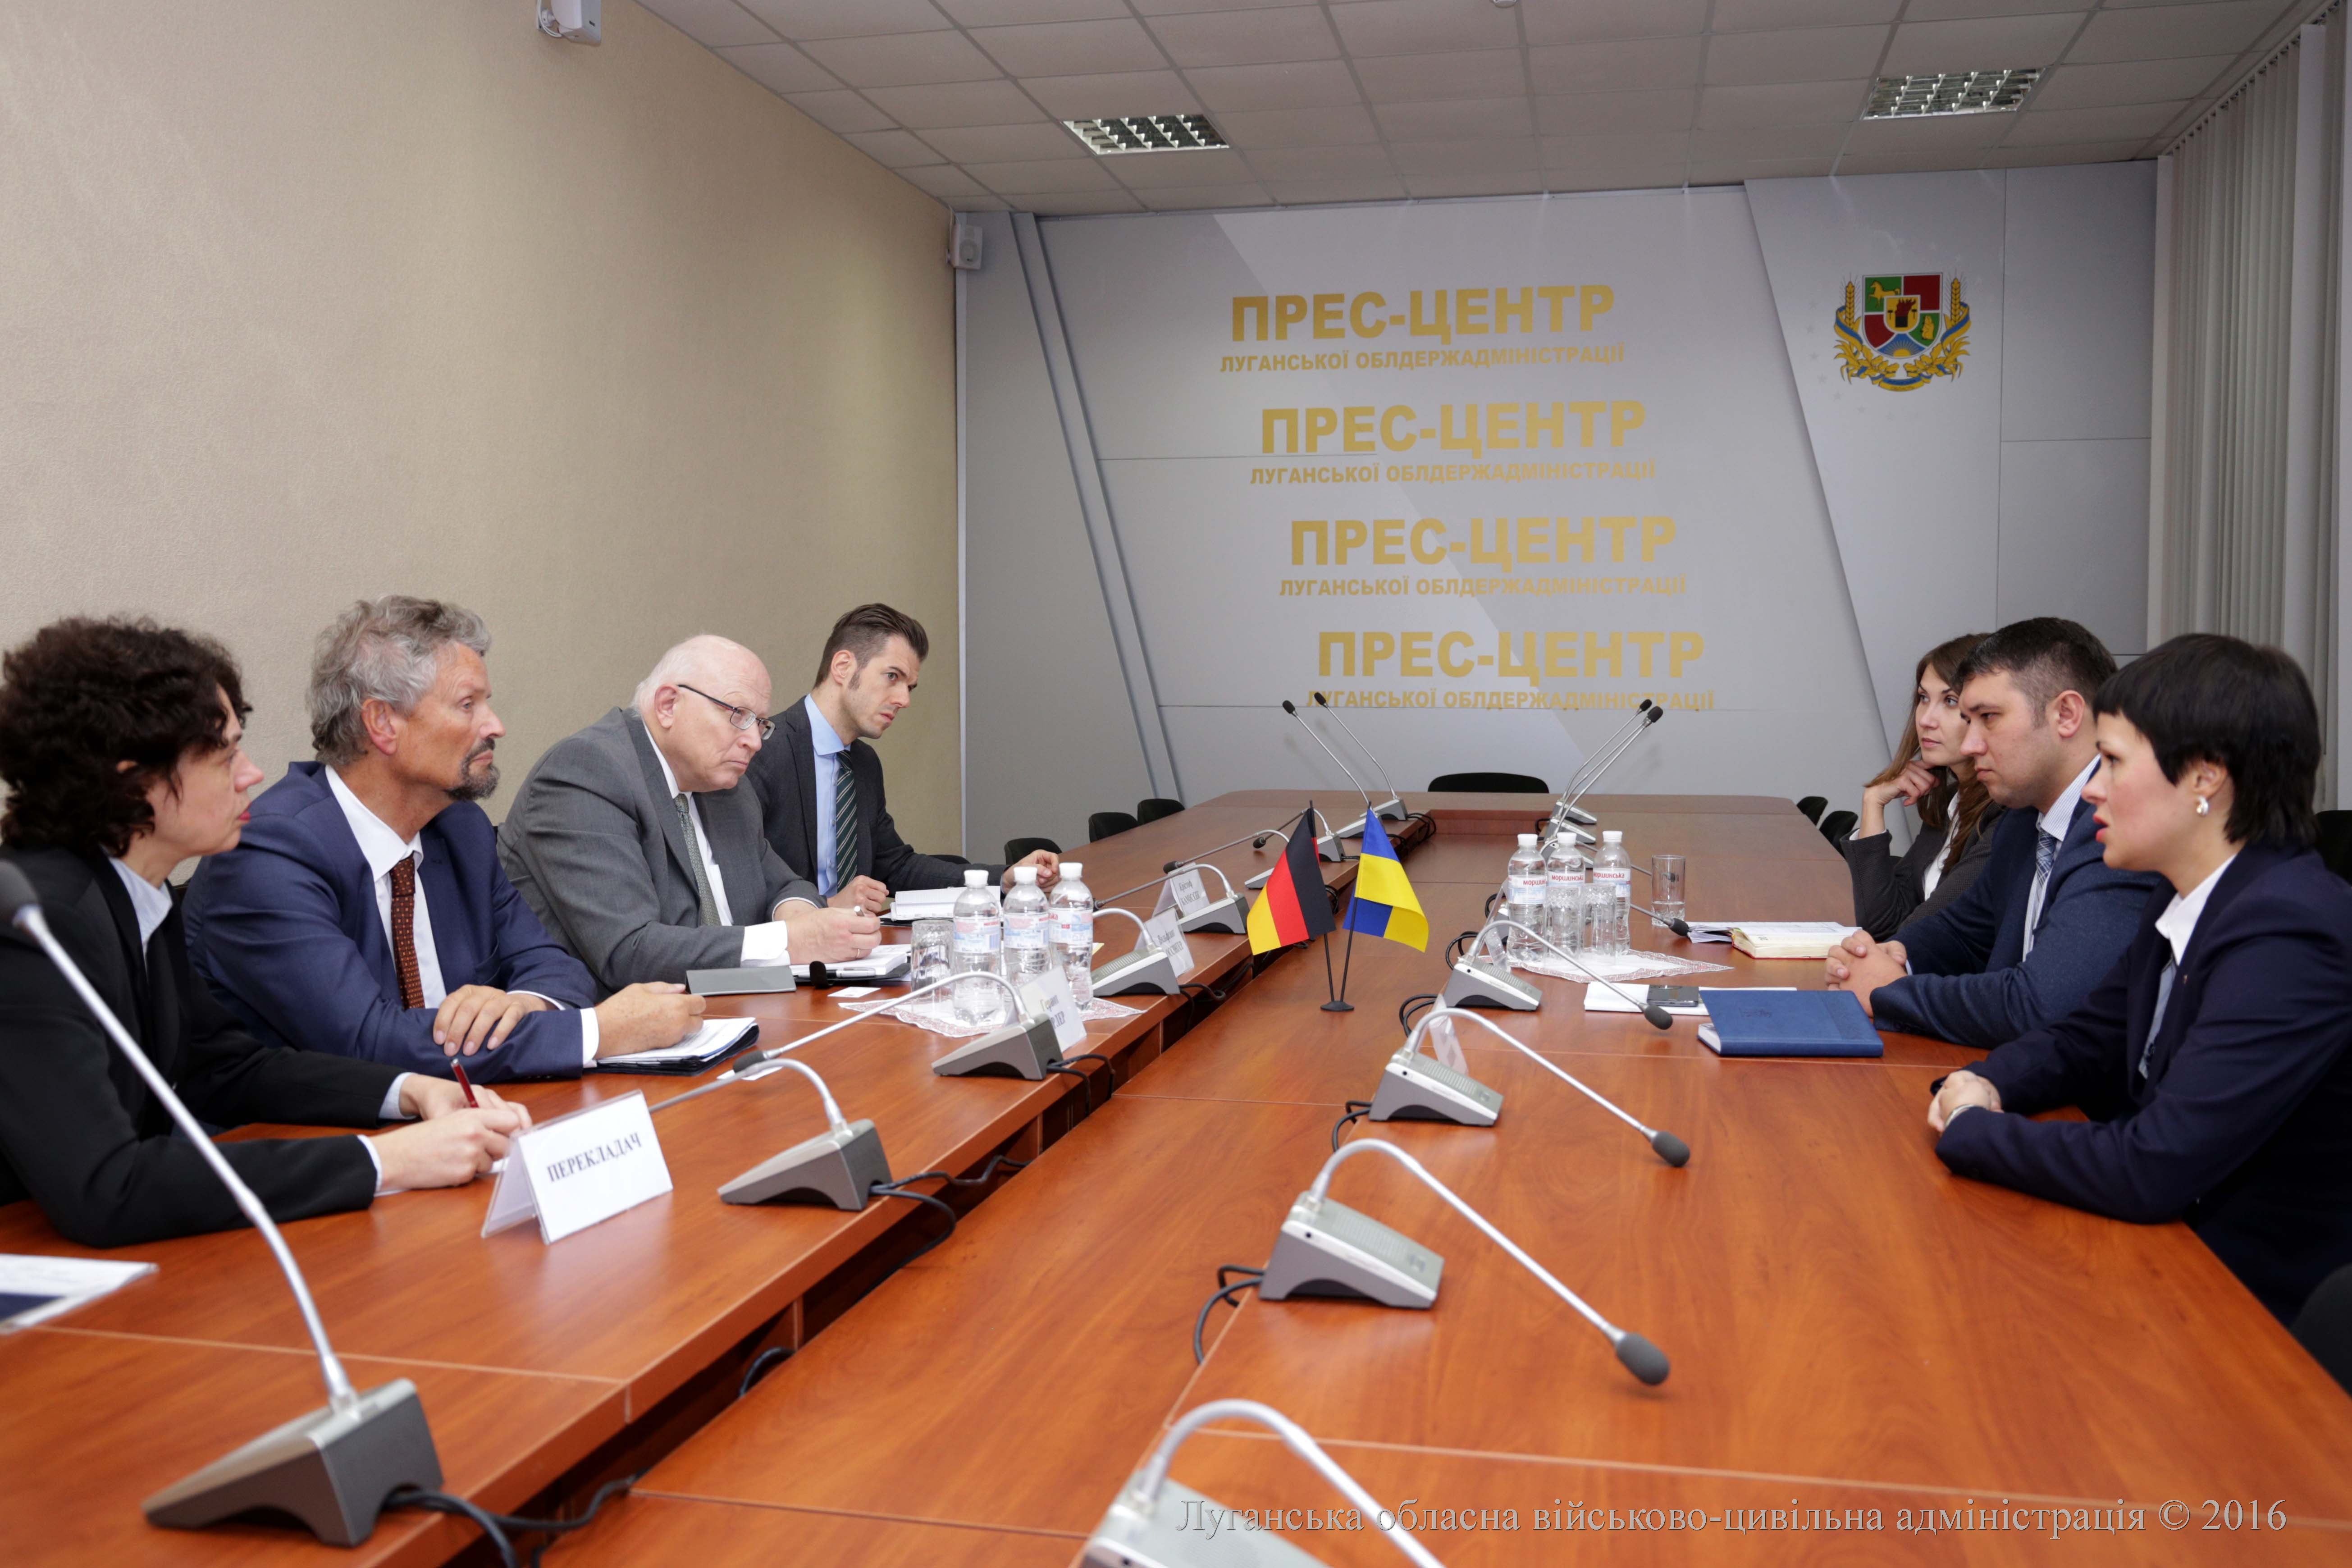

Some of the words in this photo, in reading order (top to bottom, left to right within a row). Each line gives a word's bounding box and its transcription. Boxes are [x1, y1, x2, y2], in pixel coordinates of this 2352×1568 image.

[1233, 285, 1614, 345] ПРЕС-ЦЕНТР
[1220, 349, 1349, 372] ЛУГАНСЬКОЇ
[1356, 341, 1624, 370] ОБЛДЕРЖАДМІНІСТРАЦІЇ
[1263, 400, 1645, 459] ПРЕС-ЦЕНТР
[1251, 463, 1379, 484] ЛУГАНСЬКОЇ
[1387, 458, 1656, 481] ОБЛДЕРЖАДМІНІСТРАЦІЇ
[1292, 517, 1676, 573] ПРЕС-ЦЕНТР
[1280, 576, 1409, 596] ЛУГАНСЬКОЇ
[1417, 574, 1686, 597] ОБЛДЕРЖАДМІНІСТРАЦІЇ
[1320, 631, 1704, 686] ПРЕС-ЦЕНТР
[547, 1132, 642, 1182] ПЕРЕКЛАДАЧ
